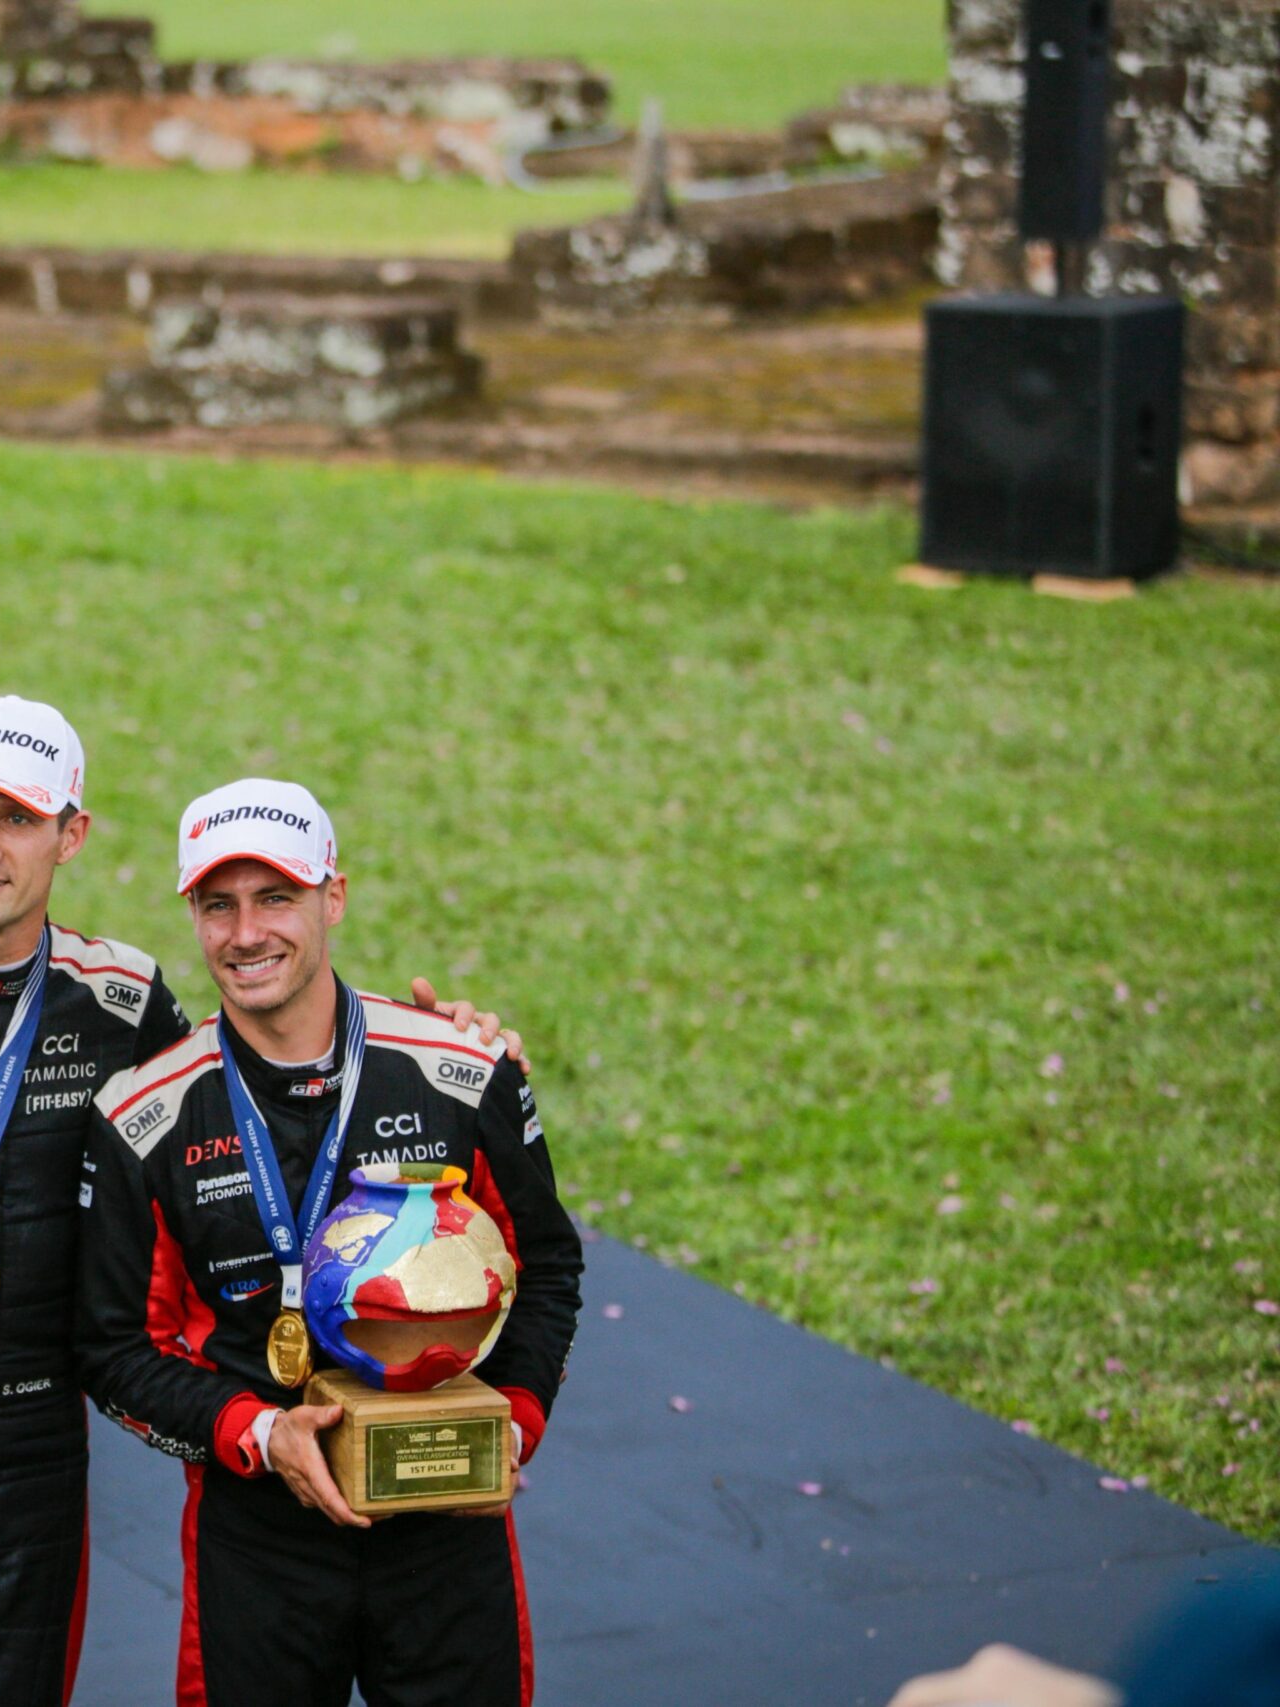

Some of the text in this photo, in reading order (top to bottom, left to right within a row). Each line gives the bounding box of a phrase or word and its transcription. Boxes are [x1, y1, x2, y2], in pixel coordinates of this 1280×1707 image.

[105, 985, 141, 1007] OMP
[4, 1055, 17, 1085] MEDAL
[23, 1062, 97, 1084] TAMADIC
[438, 1062, 485, 1087] OMP
[289, 1081, 324, 1096] GR
[125, 1102, 165, 1139] OMP
[185, 1135, 243, 1167] DENS
[357, 1142, 448, 1166] TAMADIC
[196, 1171, 251, 1194] Panason
[197, 1183, 253, 1206] AUTOMOTI
[2, 1378, 52, 1396] S. OGIER
[410, 1463, 457, 1474] 1ST PLACE
